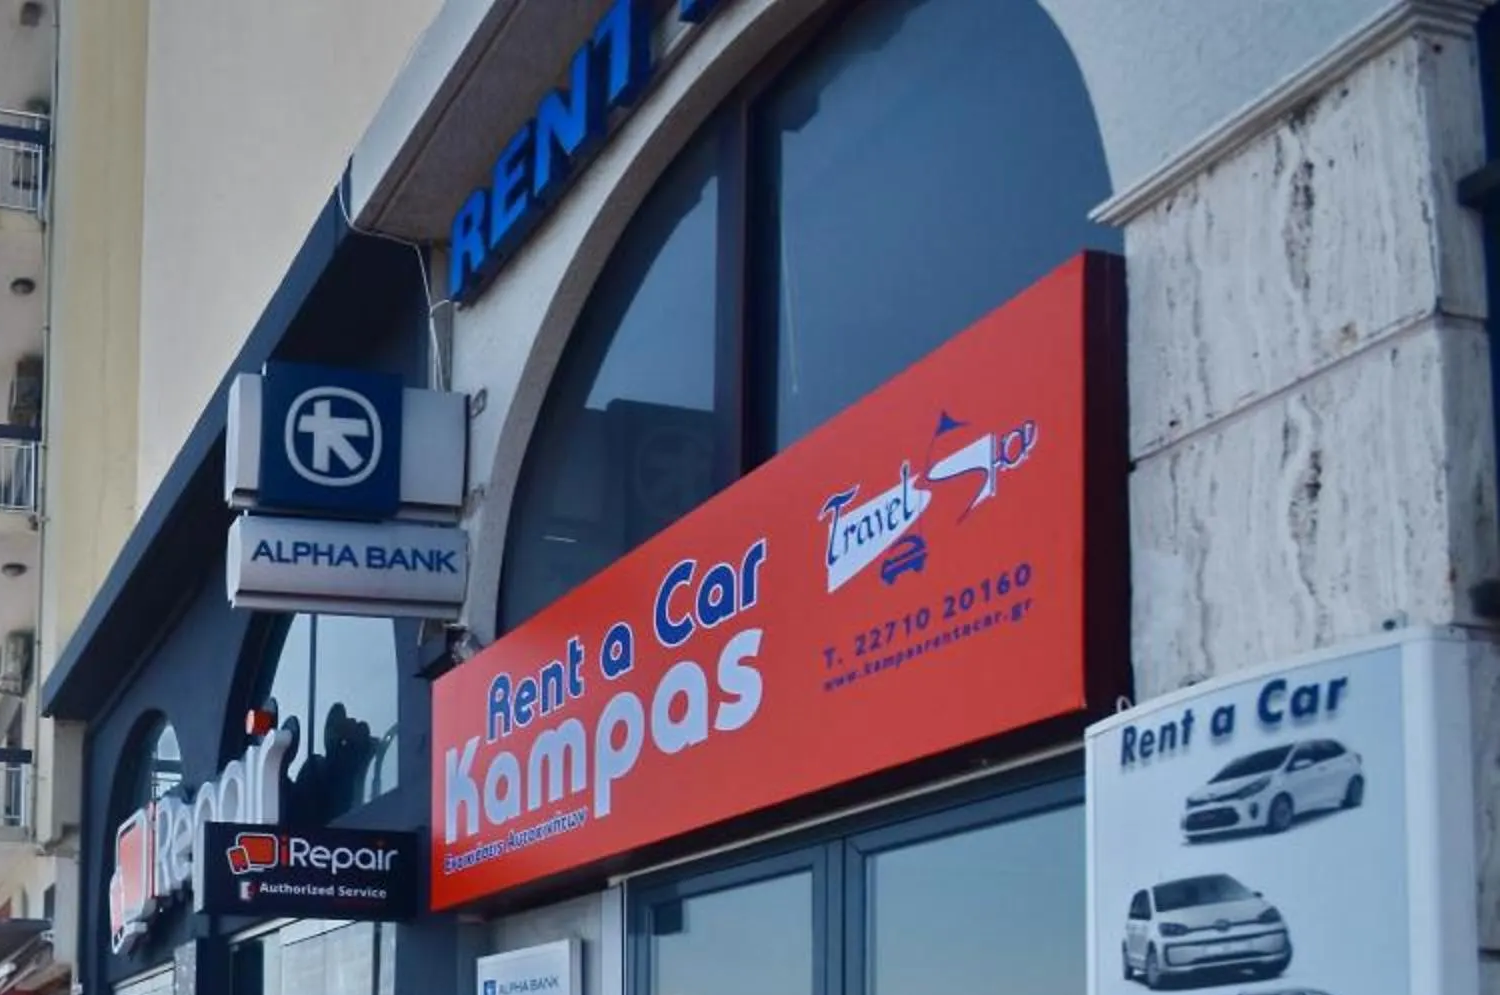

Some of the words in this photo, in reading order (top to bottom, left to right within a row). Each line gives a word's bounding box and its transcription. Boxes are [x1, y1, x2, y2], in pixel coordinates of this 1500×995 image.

[449, 0, 636, 302] RENT
[252, 540, 358, 568] ALPHA
[366, 547, 457, 573] BANK
[819, 459, 914, 567] Travel
[486, 636, 584, 744] Rent
[600, 622, 634, 680] a
[654, 538, 767, 648] Car
[823, 647, 843, 669] T.
[855, 607, 931, 657] 22710
[942, 563, 1032, 619] 20160
[444, 629, 763, 845] Kampas
[1121, 708, 1194, 766] Rent
[1210, 704, 1235, 737] a
[1257, 676, 1348, 724] Car
[259, 881, 335, 896] Authorized
[337, 884, 387, 899] Service
[280, 833, 399, 875] iRepair
